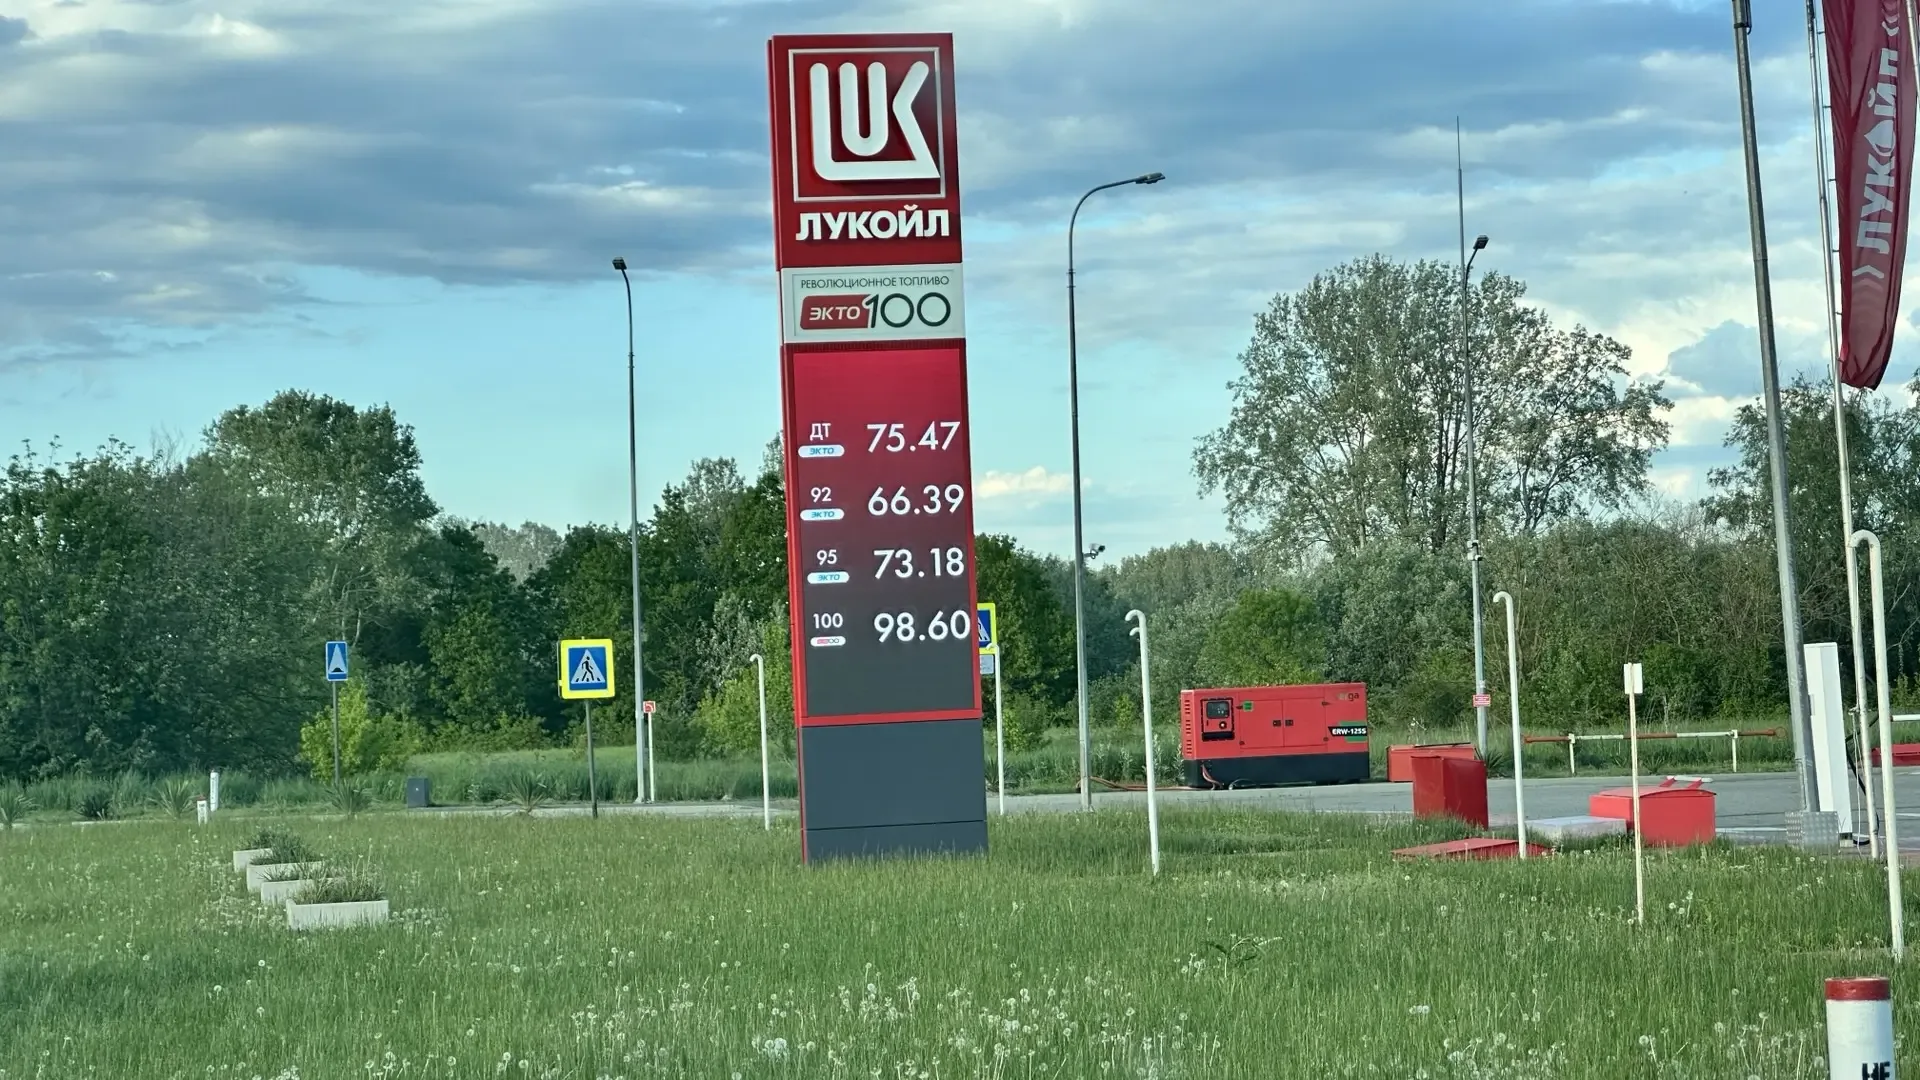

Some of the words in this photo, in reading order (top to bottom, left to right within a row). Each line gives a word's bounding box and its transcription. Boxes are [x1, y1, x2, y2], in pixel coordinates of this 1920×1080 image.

[795, 204, 950, 241] ЛУКОЙЛ
[800, 278, 897, 290] РЕВОЛЮЦИОННОЕ
[899, 275, 950, 287] ТОПЛИВО
[809, 423, 831, 441] ДТ
[866, 421, 960, 453] 75.47
[809, 447, 834, 455] ЭКТО
[810, 487, 832, 503] 92
[868, 484, 964, 516] 66.39
[816, 549, 837, 565] 95
[873, 547, 965, 580] 73.18
[813, 613, 843, 629] 100
[873, 610, 970, 643] 98.60
